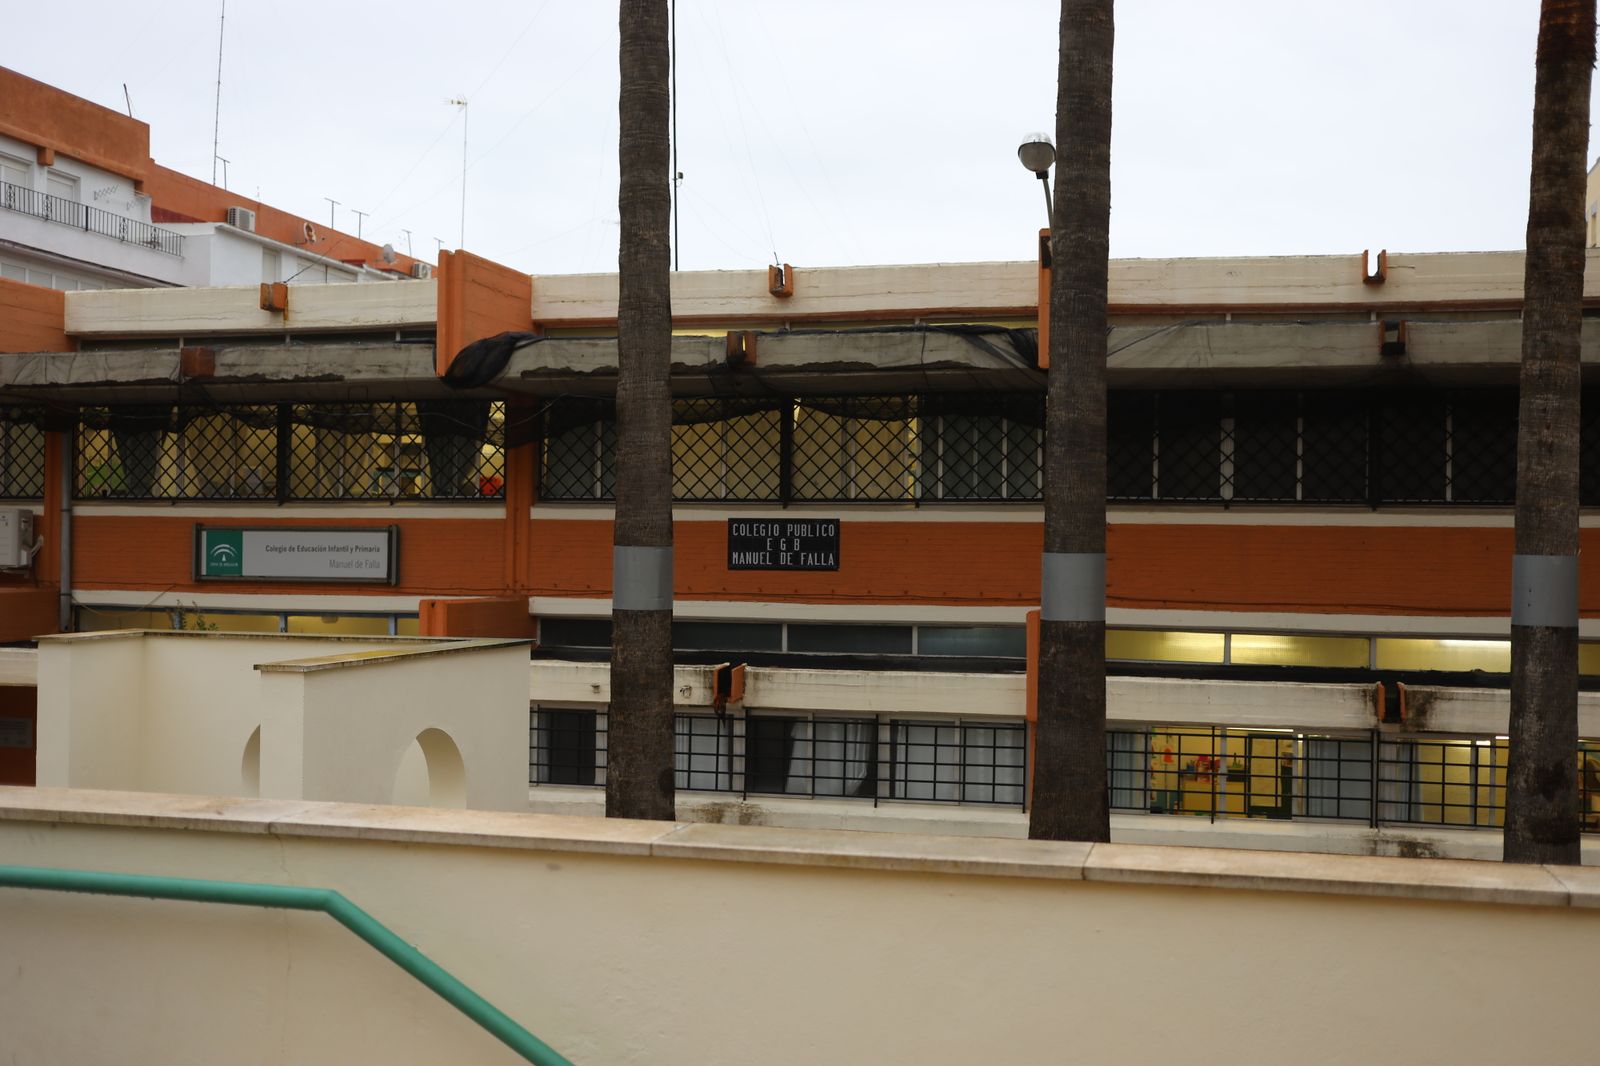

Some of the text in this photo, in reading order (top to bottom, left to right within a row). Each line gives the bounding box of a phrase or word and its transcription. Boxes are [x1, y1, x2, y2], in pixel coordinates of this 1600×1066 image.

[732, 523, 835, 537] COLEGIO PUBLICO
[265, 544, 288, 554] Colegio
[288, 544, 295, 552] de
[296, 544, 327, 552] Educación
[328, 544, 349, 552] Infantil
[355, 544, 380, 552] Primaria
[329, 559, 380, 569] Manuel de Falla
[732, 551, 834, 566] MANUEL DE FALLA
